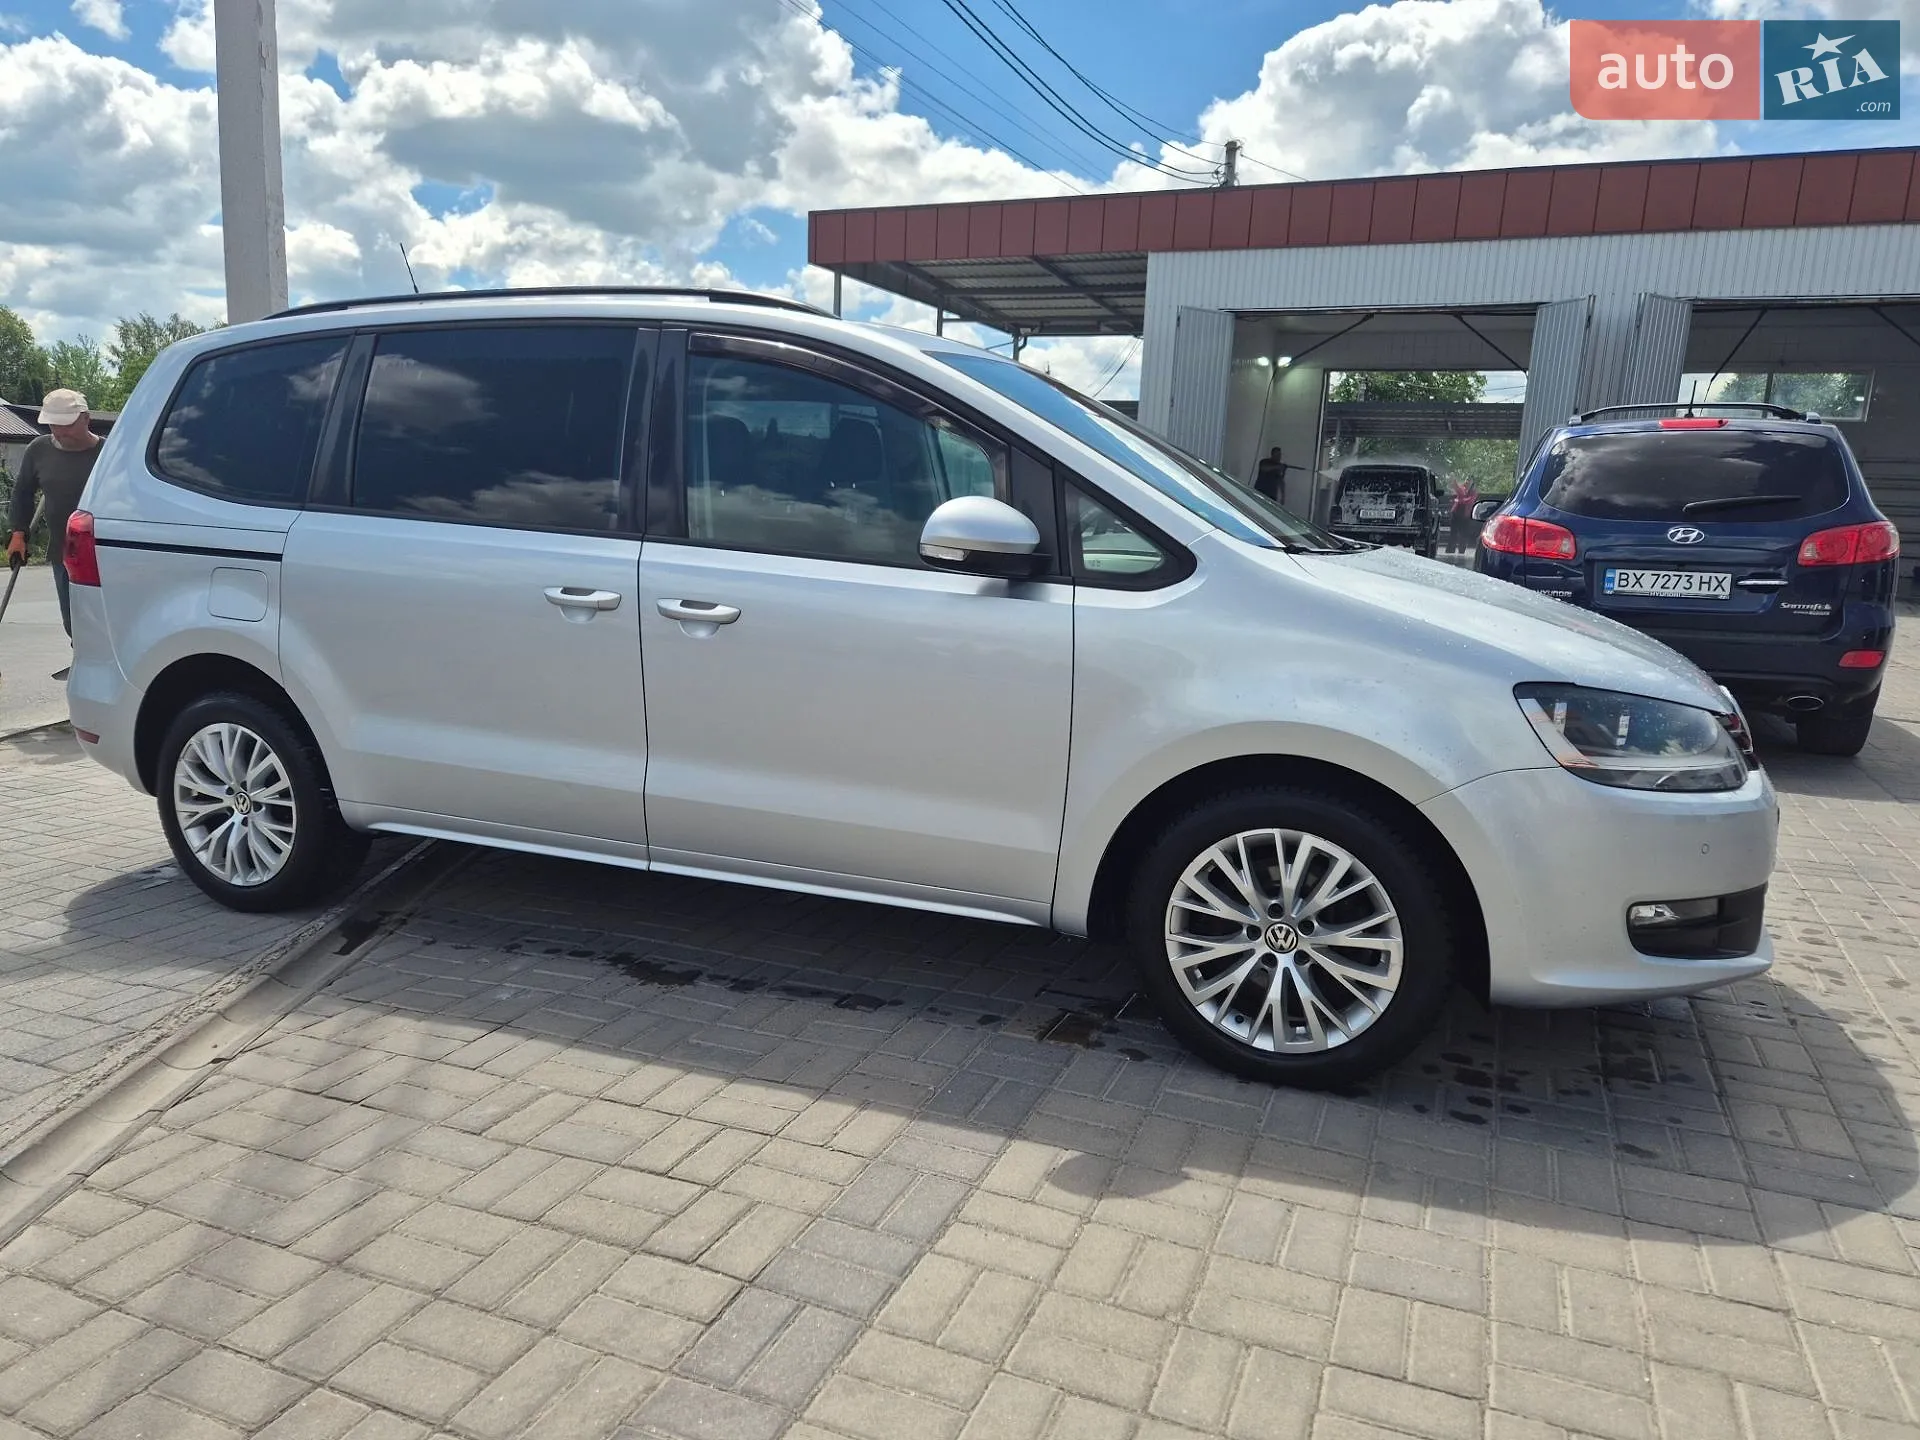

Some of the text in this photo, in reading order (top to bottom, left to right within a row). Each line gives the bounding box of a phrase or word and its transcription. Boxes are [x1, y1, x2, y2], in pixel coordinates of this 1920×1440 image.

[1617, 572, 1728, 592] BX 7273 HX
[1267, 923, 1297, 952] VW
